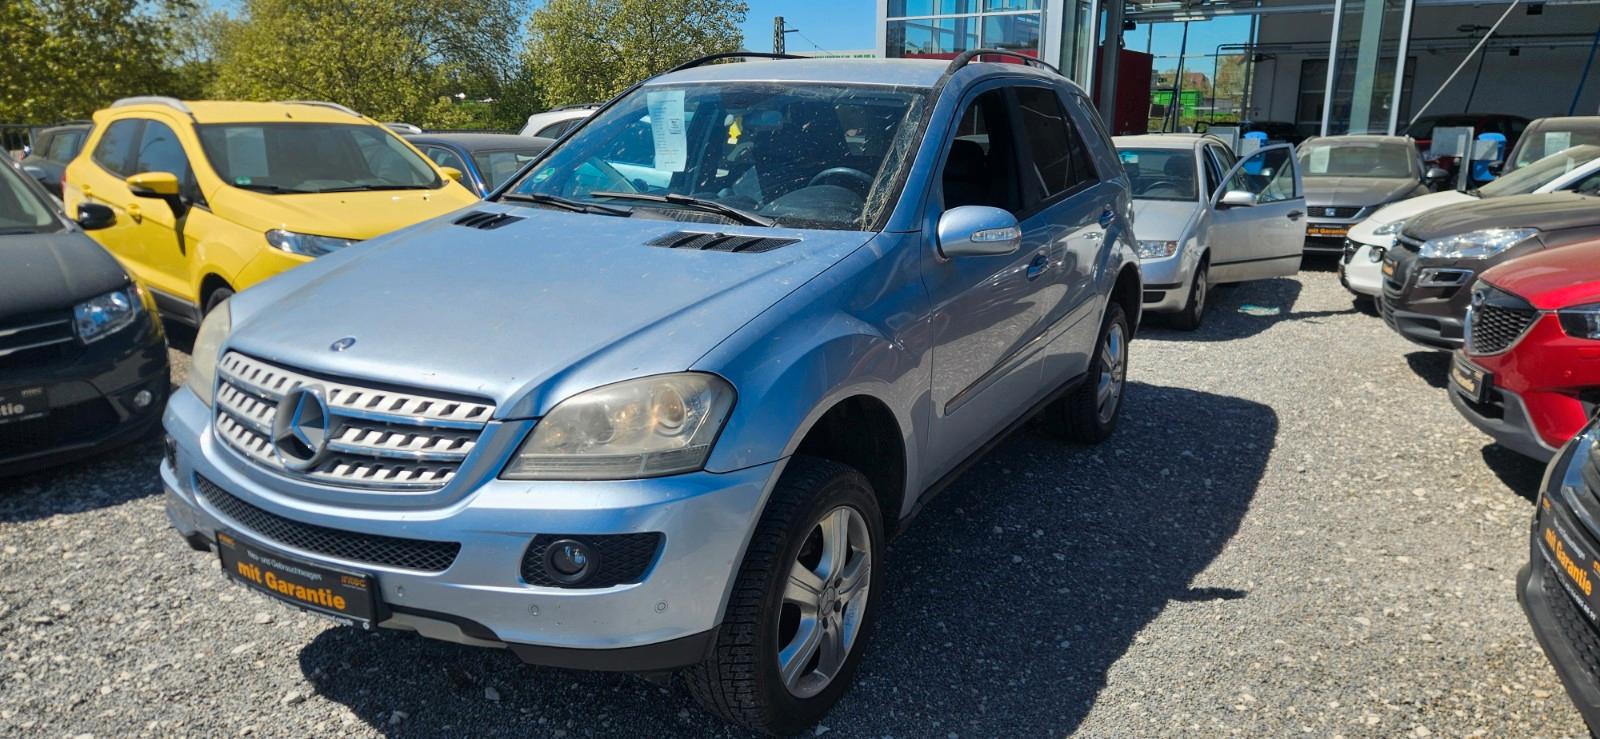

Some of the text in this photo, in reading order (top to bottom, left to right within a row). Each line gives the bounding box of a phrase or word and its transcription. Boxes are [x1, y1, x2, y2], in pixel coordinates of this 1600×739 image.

[237, 561, 347, 610] mit Garantie
[1545, 527, 1557, 552] mit
[1556, 540, 1592, 596] Garantie
